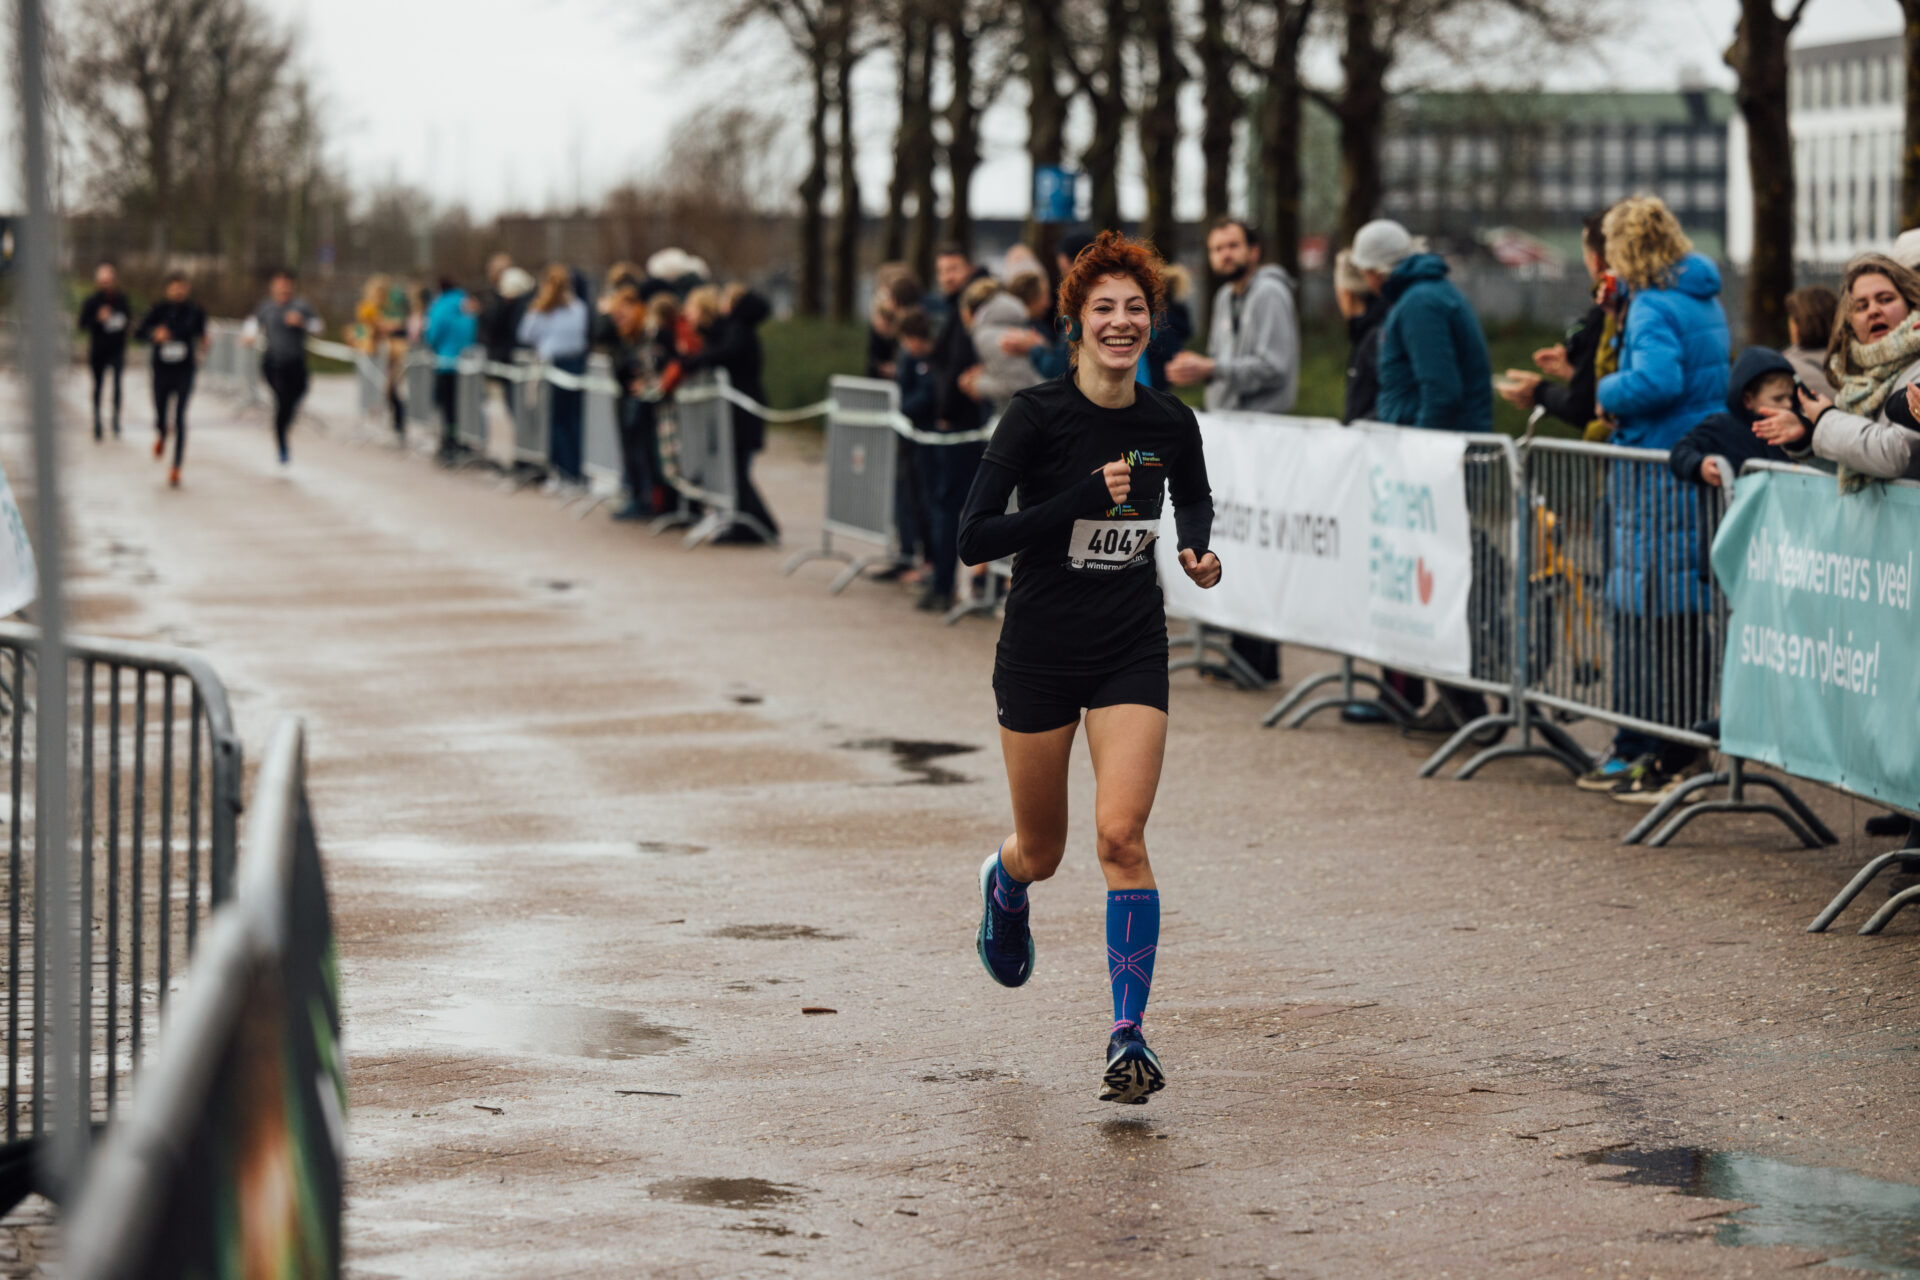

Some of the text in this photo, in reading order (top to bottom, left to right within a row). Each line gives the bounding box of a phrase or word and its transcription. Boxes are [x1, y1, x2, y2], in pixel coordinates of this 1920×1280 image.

[1088, 529, 1148, 556] 4047
[1876, 550, 1913, 611] veel
[1817, 627, 1880, 697] pleier!
